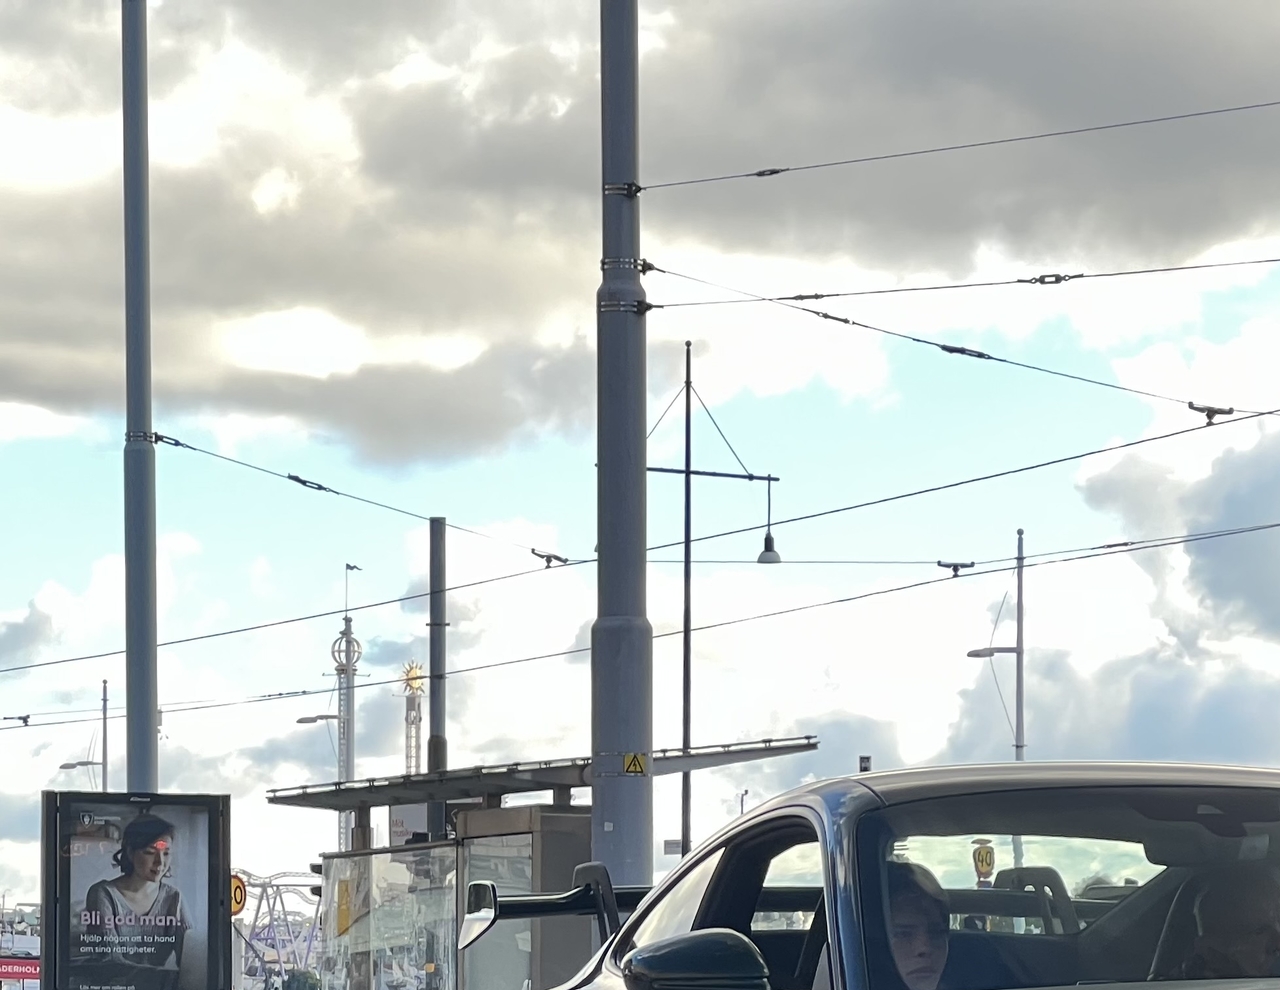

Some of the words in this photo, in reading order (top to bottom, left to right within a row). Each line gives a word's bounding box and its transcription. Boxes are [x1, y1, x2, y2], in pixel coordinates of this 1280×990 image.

[80, 910, 100, 925] Bli
[104, 911, 136, 929] god
[140, 912, 182, 926] man!
[80, 934, 102, 943] Hjälp
[103, 934, 130, 944] någon
[131, 935, 142, 943] att
[144, 935, 153, 943] ta
[154, 935, 176, 943] hand
[95, 945, 111, 953] sina
